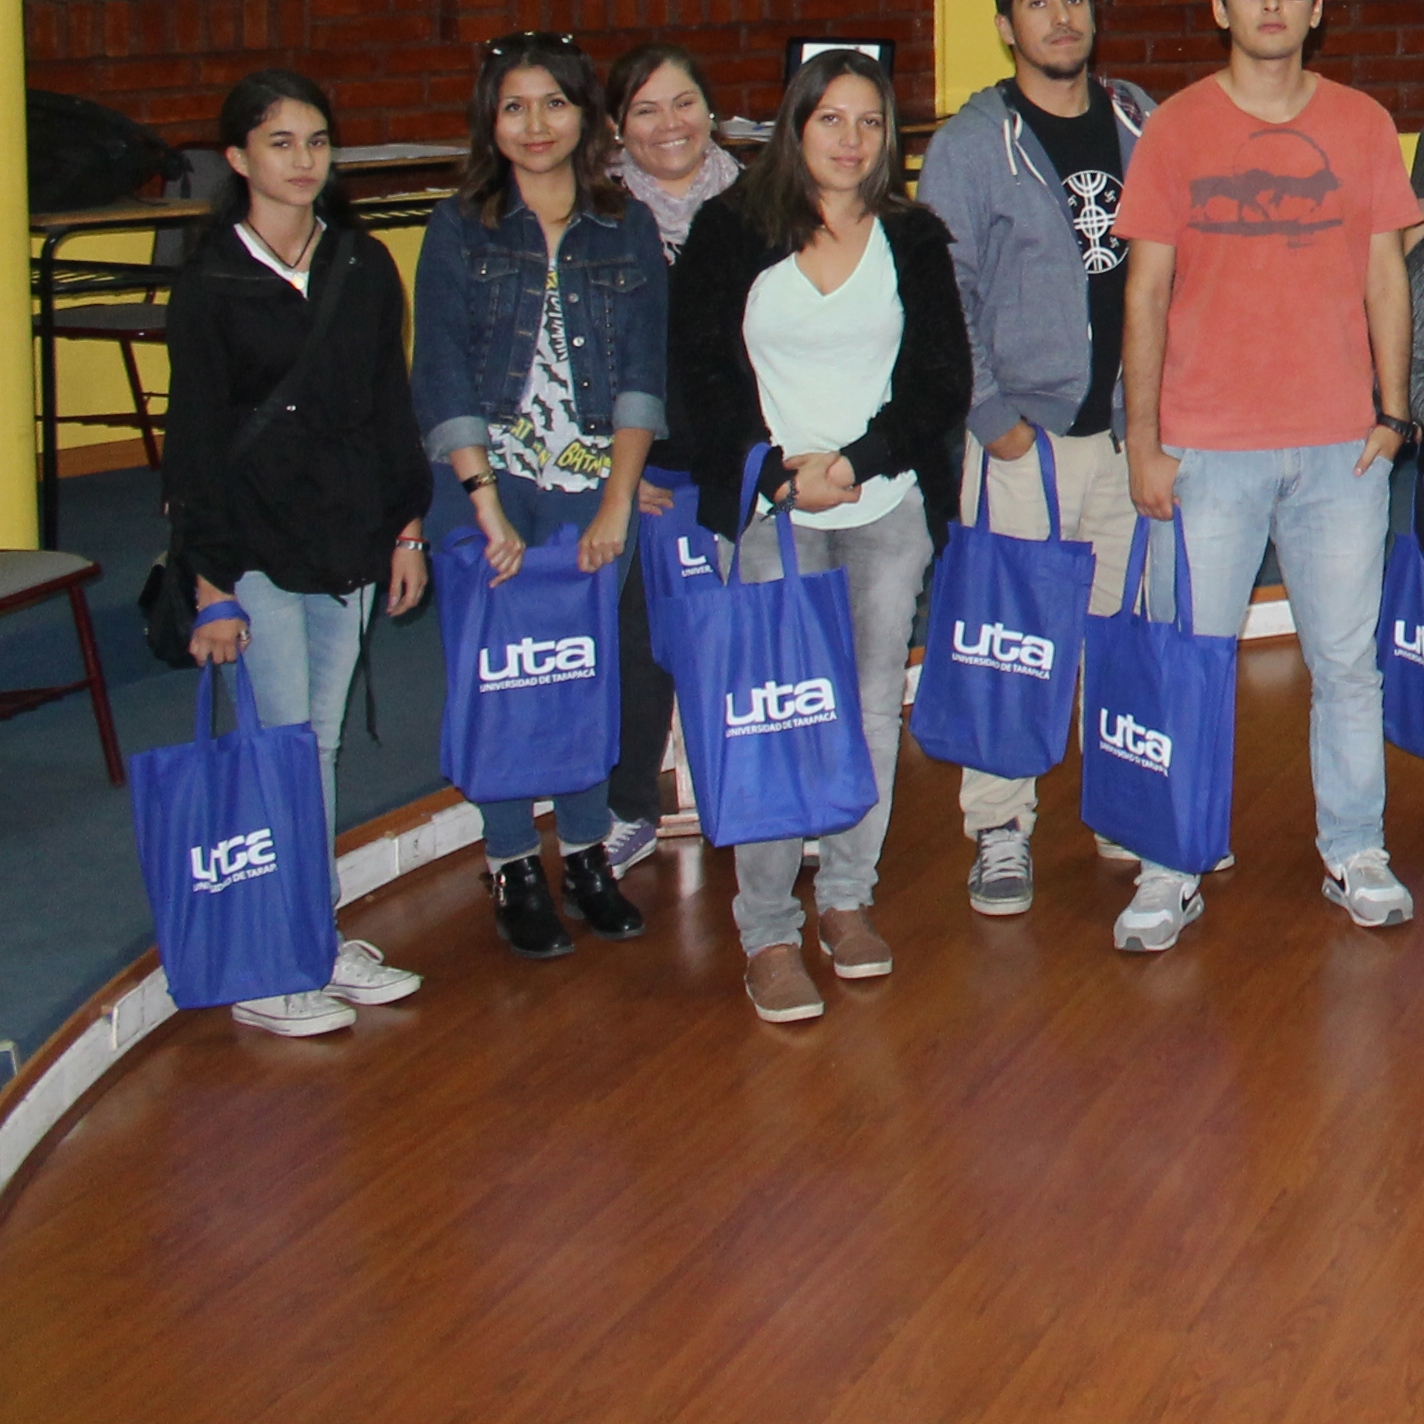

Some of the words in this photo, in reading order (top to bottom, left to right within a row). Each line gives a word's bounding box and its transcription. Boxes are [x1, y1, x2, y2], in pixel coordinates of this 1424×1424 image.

[479, 635, 597, 683] uta
[952, 619, 1056, 671] uta
[479, 676, 539, 694] UNIVERSIDAD
[538, 674, 553, 686] DE
[725, 677, 837, 727] uta
[1099, 707, 1173, 769] uta
